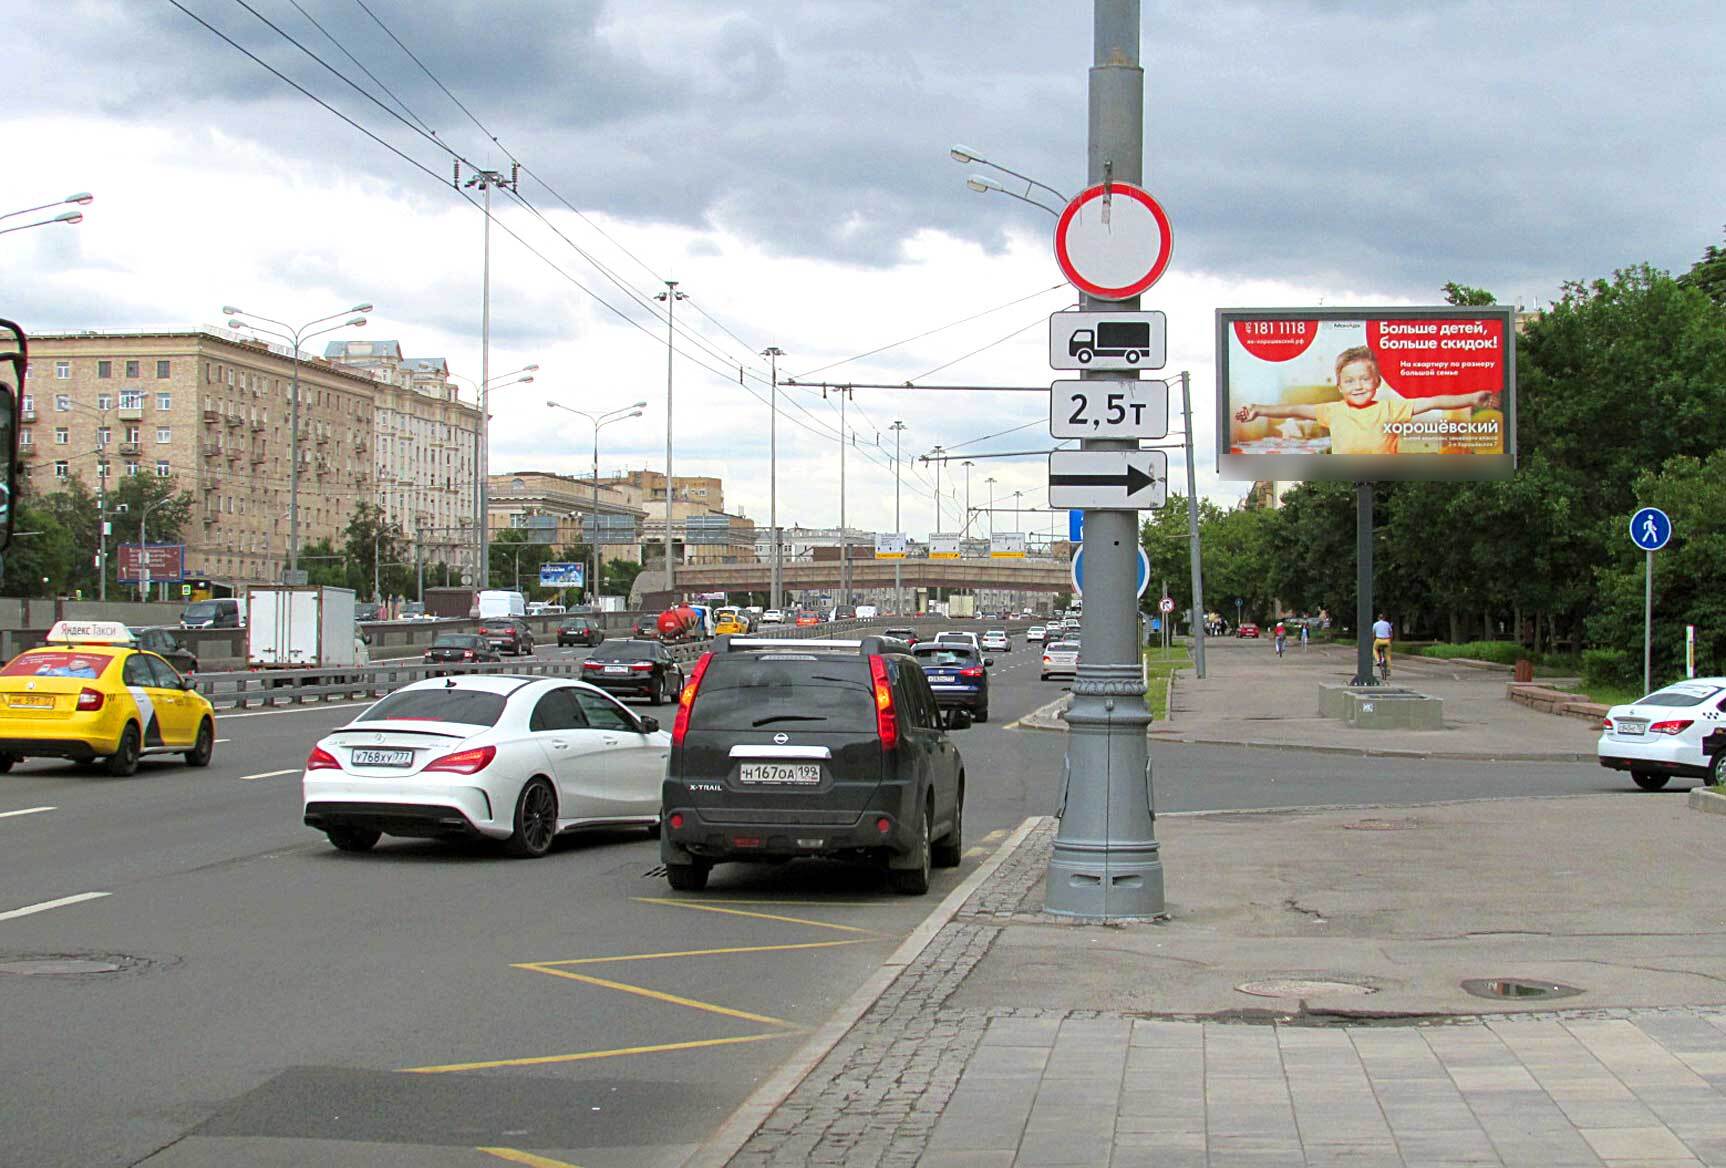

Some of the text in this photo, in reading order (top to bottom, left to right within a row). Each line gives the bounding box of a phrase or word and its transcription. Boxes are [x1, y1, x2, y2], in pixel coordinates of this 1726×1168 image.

[1254, 322, 1274, 335] 181
[1279, 322, 1306, 335] 1118
[1379, 321, 1488, 336] Больше детей,
[1379, 335, 1498, 351] больше скидок!
[1412, 361, 1449, 369] квартиру
[1461, 361, 1496, 369] размеру
[1383, 419, 1499, 436] хорошёвский
[61, 623, 117, 636] Яндекс Такси
